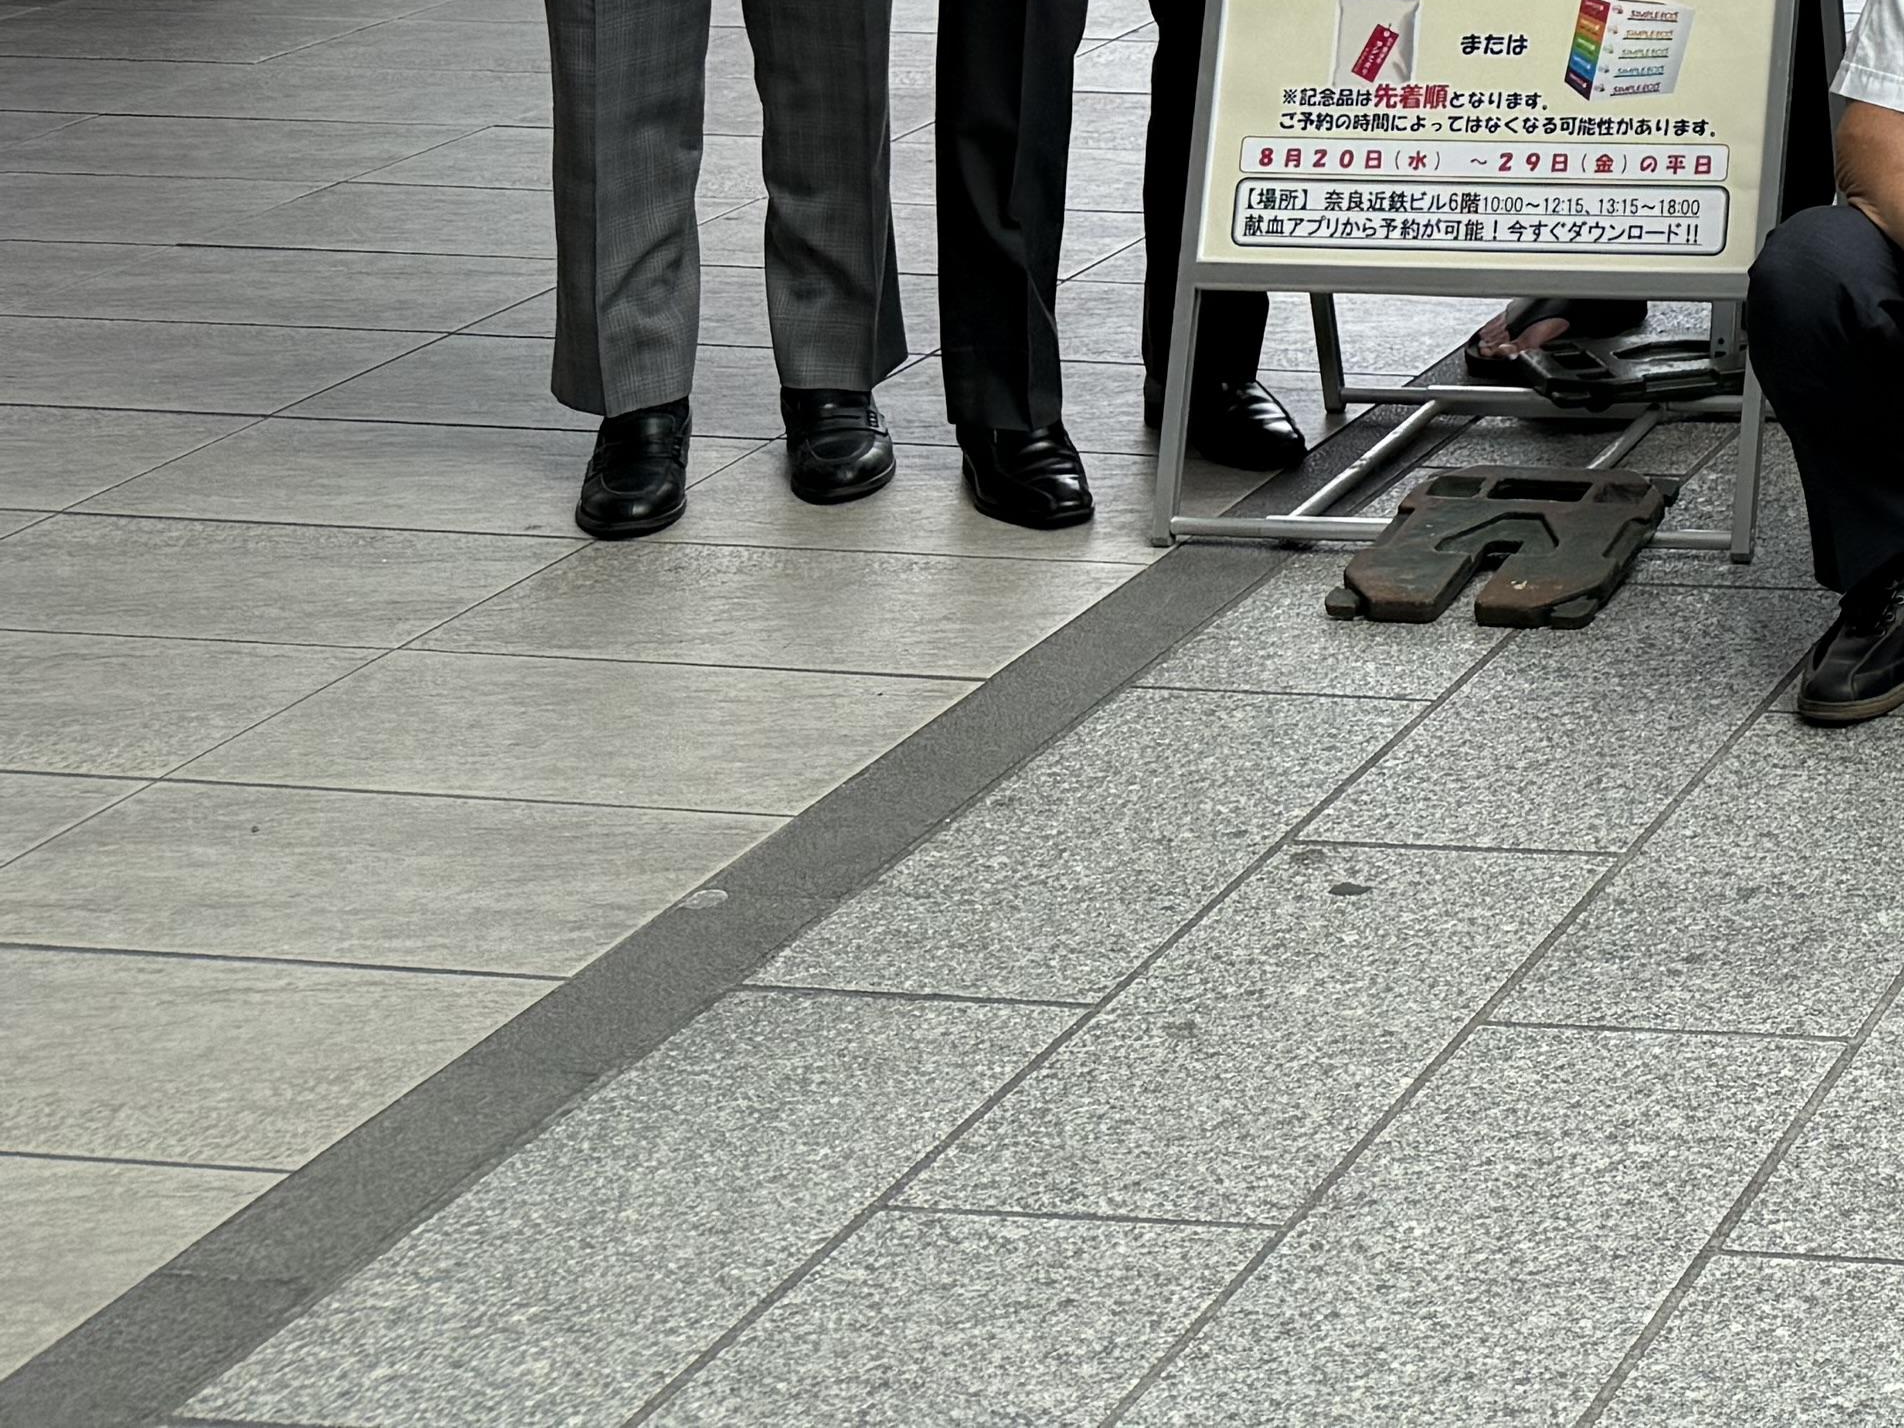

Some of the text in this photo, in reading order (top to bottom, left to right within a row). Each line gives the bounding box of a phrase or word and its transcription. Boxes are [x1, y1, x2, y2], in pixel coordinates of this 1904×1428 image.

[1460, 34, 1528, 56] または
[1283, 84, 1548, 111] ※記念品は先着順となります。
[1279, 112, 1716, 137] ご予約の時間によってはなくなる可能性があります。
[1245, 187, 1308, 211] 【場所】
